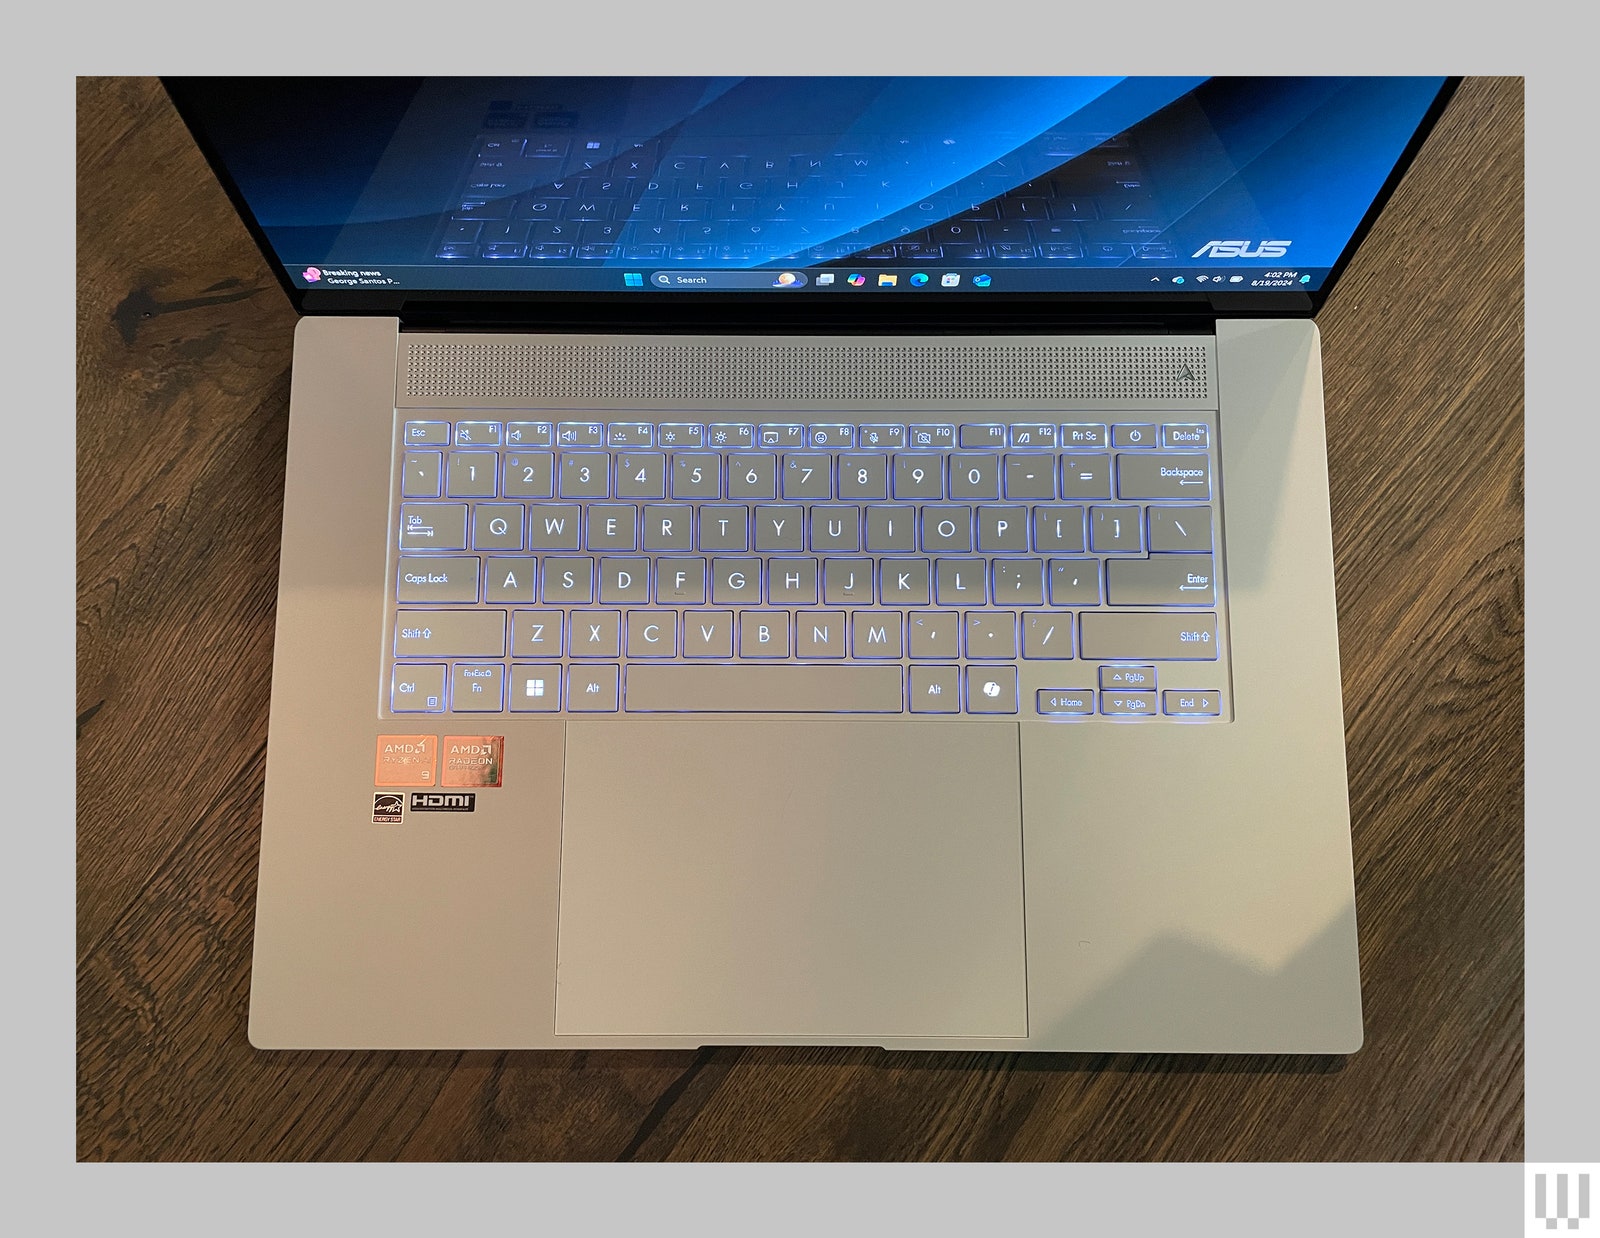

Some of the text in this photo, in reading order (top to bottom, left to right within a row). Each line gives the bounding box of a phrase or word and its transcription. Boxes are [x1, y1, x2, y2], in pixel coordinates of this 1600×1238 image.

[1191, 240, 1292, 258] ASUS
[677, 276, 707, 284] Search
[488, 424, 498, 433] F1
[537, 425, 548, 434] F2
[588, 426, 599, 434] F3
[637, 426, 649, 435] F4
[688, 426, 699, 435] F5
[738, 427, 750, 435] F6
[788, 427, 799, 436] F7
[839, 427, 850, 436] F8
[888, 427, 900, 436] F9
[936, 428, 951, 437] F10
[989, 428, 1002, 436] F11
[1038, 428, 1052, 436] F12
[1071, 431, 1097, 442] Prt Sc
[1172, 431, 1199, 442] Delete
[469, 466, 475, 481] 1
[523, 467, 533, 481] 2
[580, 467, 589, 482] 3
[635, 468, 646, 482] 4
[691, 468, 701, 483] 5
[746, 469, 757, 483] 6
[802, 469, 812, 483] 7
[858, 469, 867, 484] 8
[913, 469, 924, 483] 9
[969, 469, 980, 484] 0
[1159, 467, 1204, 478] Backspace
[407, 515, 423, 526] Tab
[490, 518, 507, 534] Q
[545, 519, 564, 534] W
[607, 519, 616, 535] E
[662, 520, 672, 535] R
[719, 520, 728, 536] T
[773, 520, 784, 536] Y
[829, 520, 841, 536] U
[938, 521, 955, 537] O
[998, 521, 1008, 536] P
[404, 573, 448, 585] Caps Lock
[503, 572, 517, 587] A
[563, 572, 573, 588] S
[619, 572, 631, 588] D
[676, 572, 685, 588] F
[729, 573, 745, 589] G
[784, 571, 800, 590] H
[845, 573, 853, 589] J
[899, 573, 910, 589] K
[956, 574, 966, 589] L
[1187, 573, 1209, 585] Enter
[401, 628, 421, 639] Shift
[531, 625, 543, 641] Z
[590, 625, 600, 641] X
[644, 626, 658, 642] C
[701, 626, 714, 642] V
[759, 626, 769, 642] B
[814, 626, 827, 642] N
[868, 627, 886, 643] M
[1180, 631, 1200, 642] Shift
[1124, 672, 1145, 684] PgUp
[399, 682, 415, 693] Ctrl
[472, 683, 482, 693] Fn
[586, 683, 599, 693] Alt
[928, 685, 942, 695] Alt
[1060, 698, 1083, 707] Home
[1126, 699, 1146, 710] PgDn
[1179, 698, 1195, 708] End
[384, 744, 414, 753] AMD
[450, 745, 480, 754] AMD
[449, 757, 492, 765] RADEON
[421, 771, 430, 779] 9
[412, 795, 470, 806] HDMI
